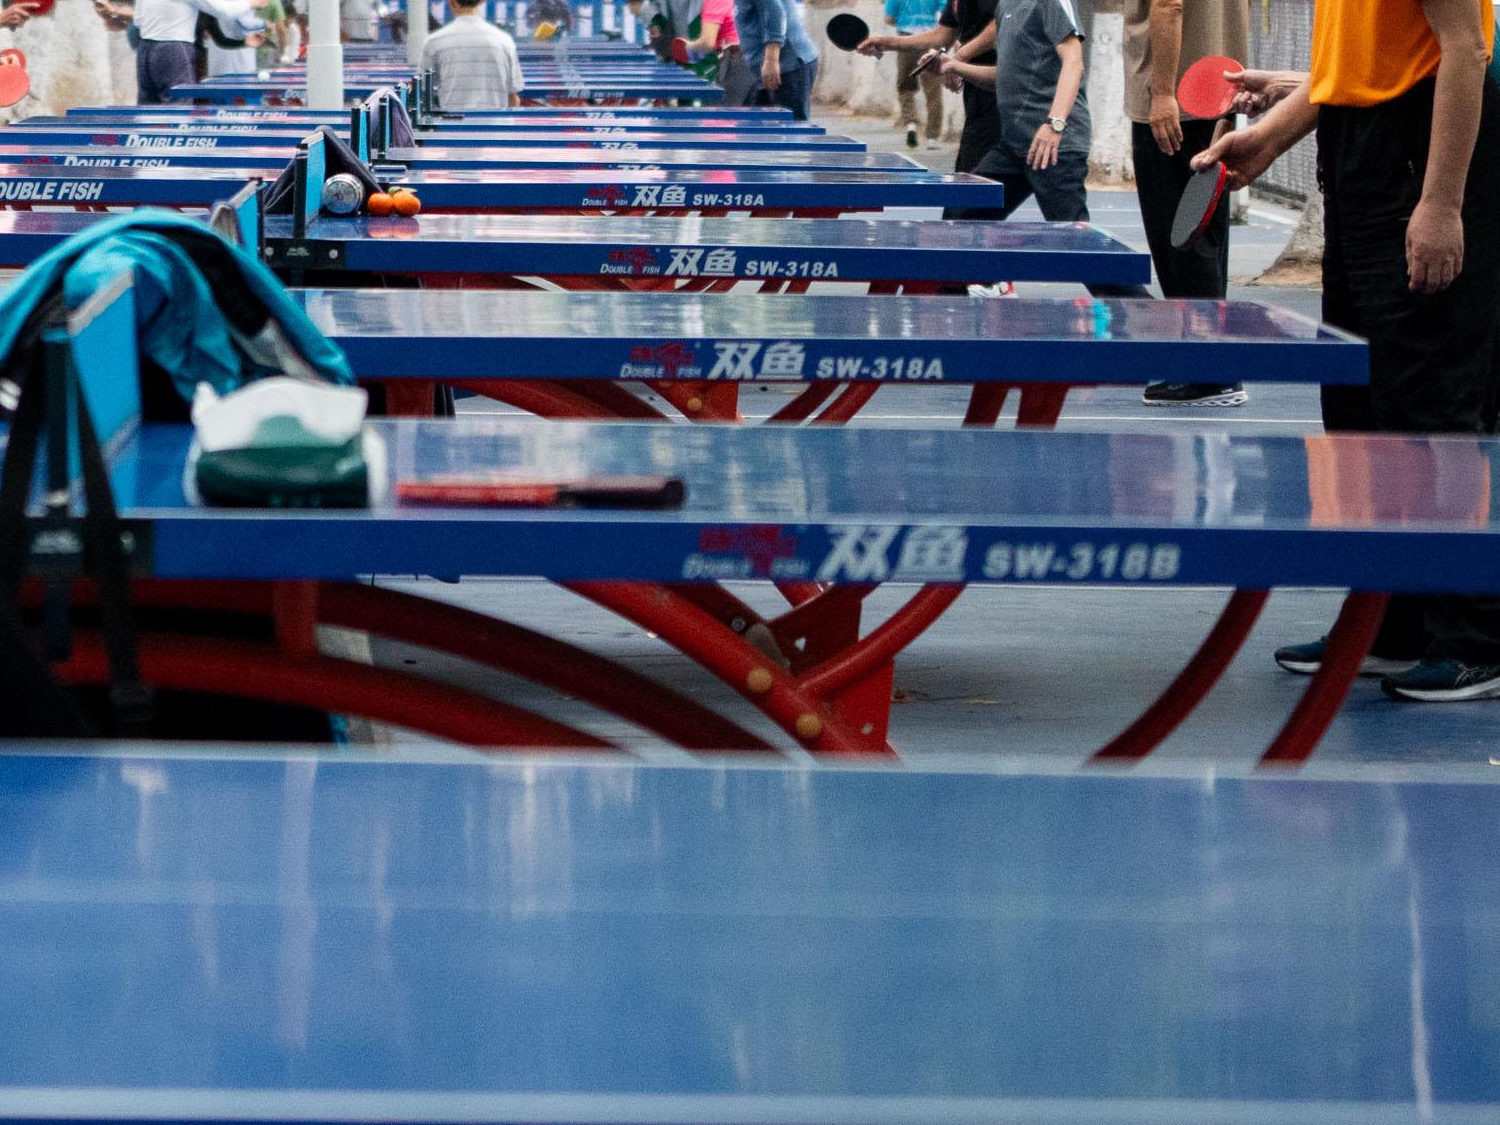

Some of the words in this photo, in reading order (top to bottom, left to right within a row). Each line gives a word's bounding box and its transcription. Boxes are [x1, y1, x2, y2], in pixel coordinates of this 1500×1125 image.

[56, 182, 103, 201] FISH
[631, 185, 686, 207] 双鱼
[693, 194, 764, 206] SW-318A
[600, 264, 633, 275] DOUBLE
[643, 266, 660, 275] FISH
[664, 247, 738, 277] 双鱼
[744, 260, 839, 277] SW-318A
[707, 340, 807, 380] 双鱼
[816, 356, 945, 380] SW-318A
[815, 524, 970, 582] 双鱼
[983, 543, 1181, 580] SW-318B
